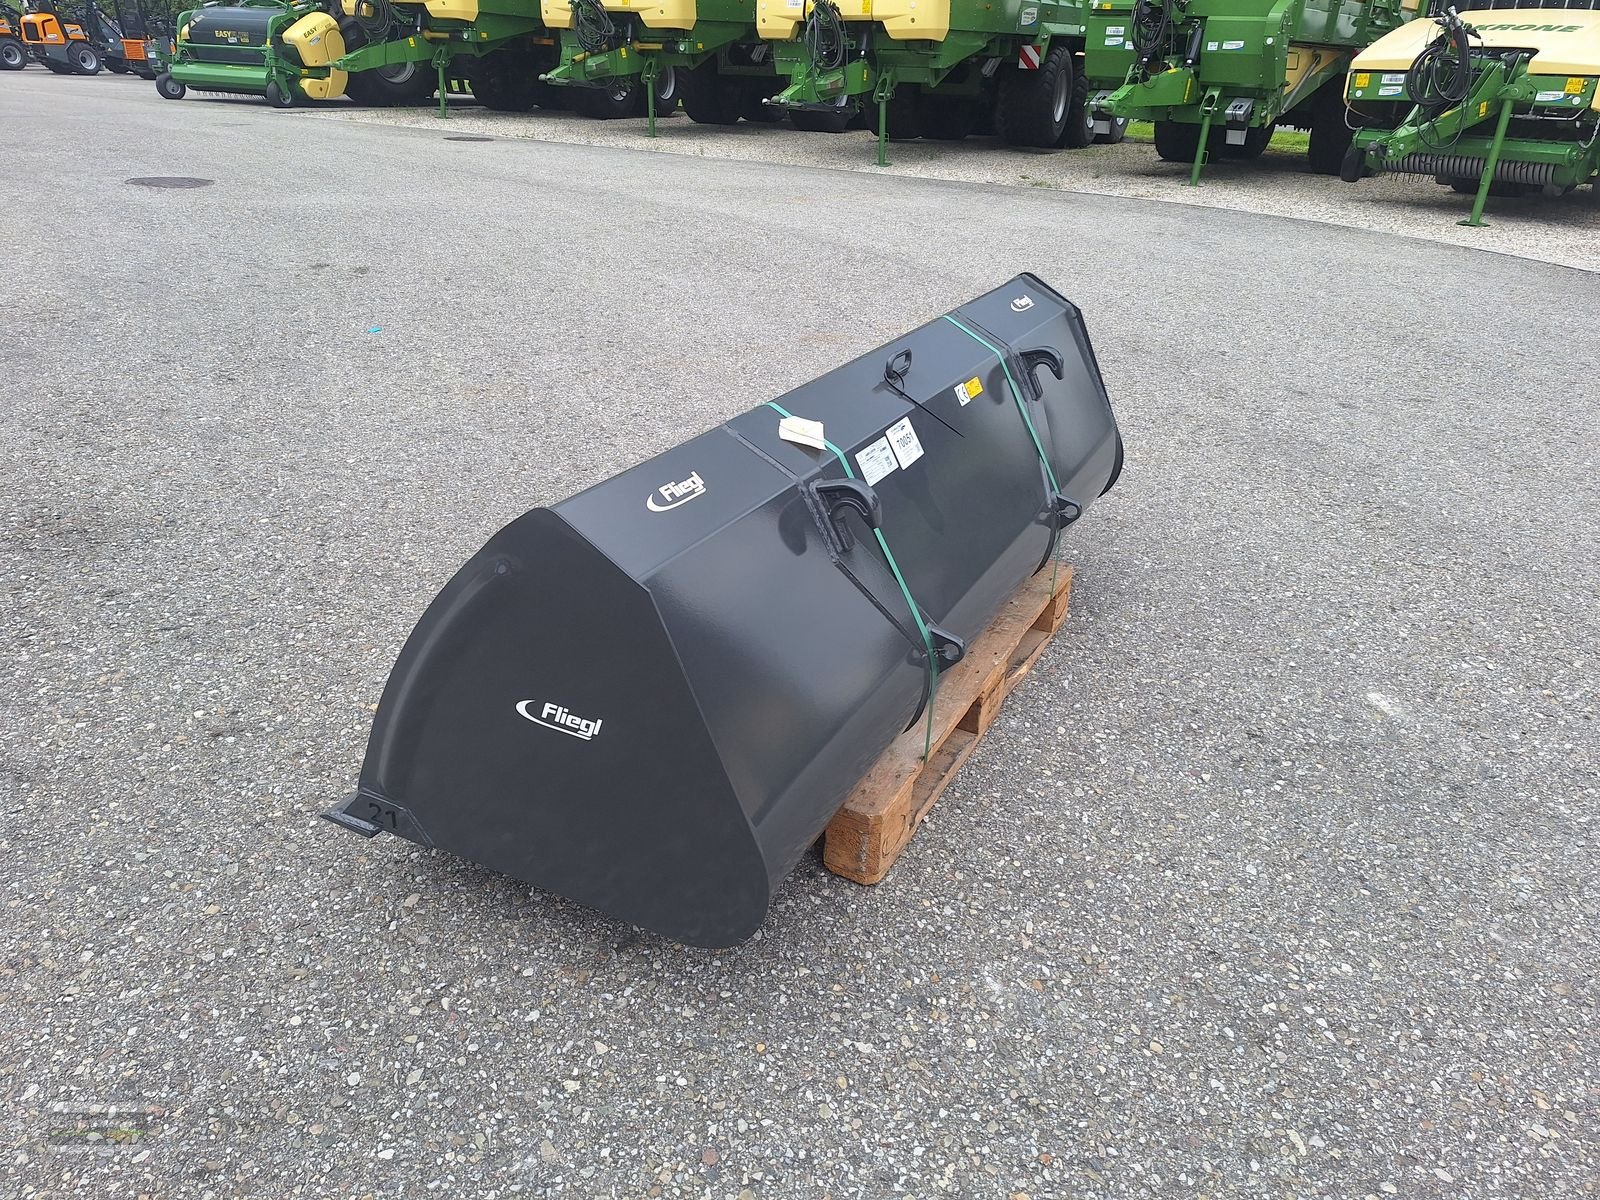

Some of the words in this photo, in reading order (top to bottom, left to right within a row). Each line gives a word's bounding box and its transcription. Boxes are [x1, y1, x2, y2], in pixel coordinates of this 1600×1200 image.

[214, 30, 232, 38] EASY
[303, 26, 318, 39] EASY
[1473, 24, 1584, 33] KRONE
[1012, 294, 1033, 308] Fliegl
[896, 431, 915, 450] 70051
[658, 470, 705, 502] Fliegl
[541, 702, 603, 738] Fliegl
